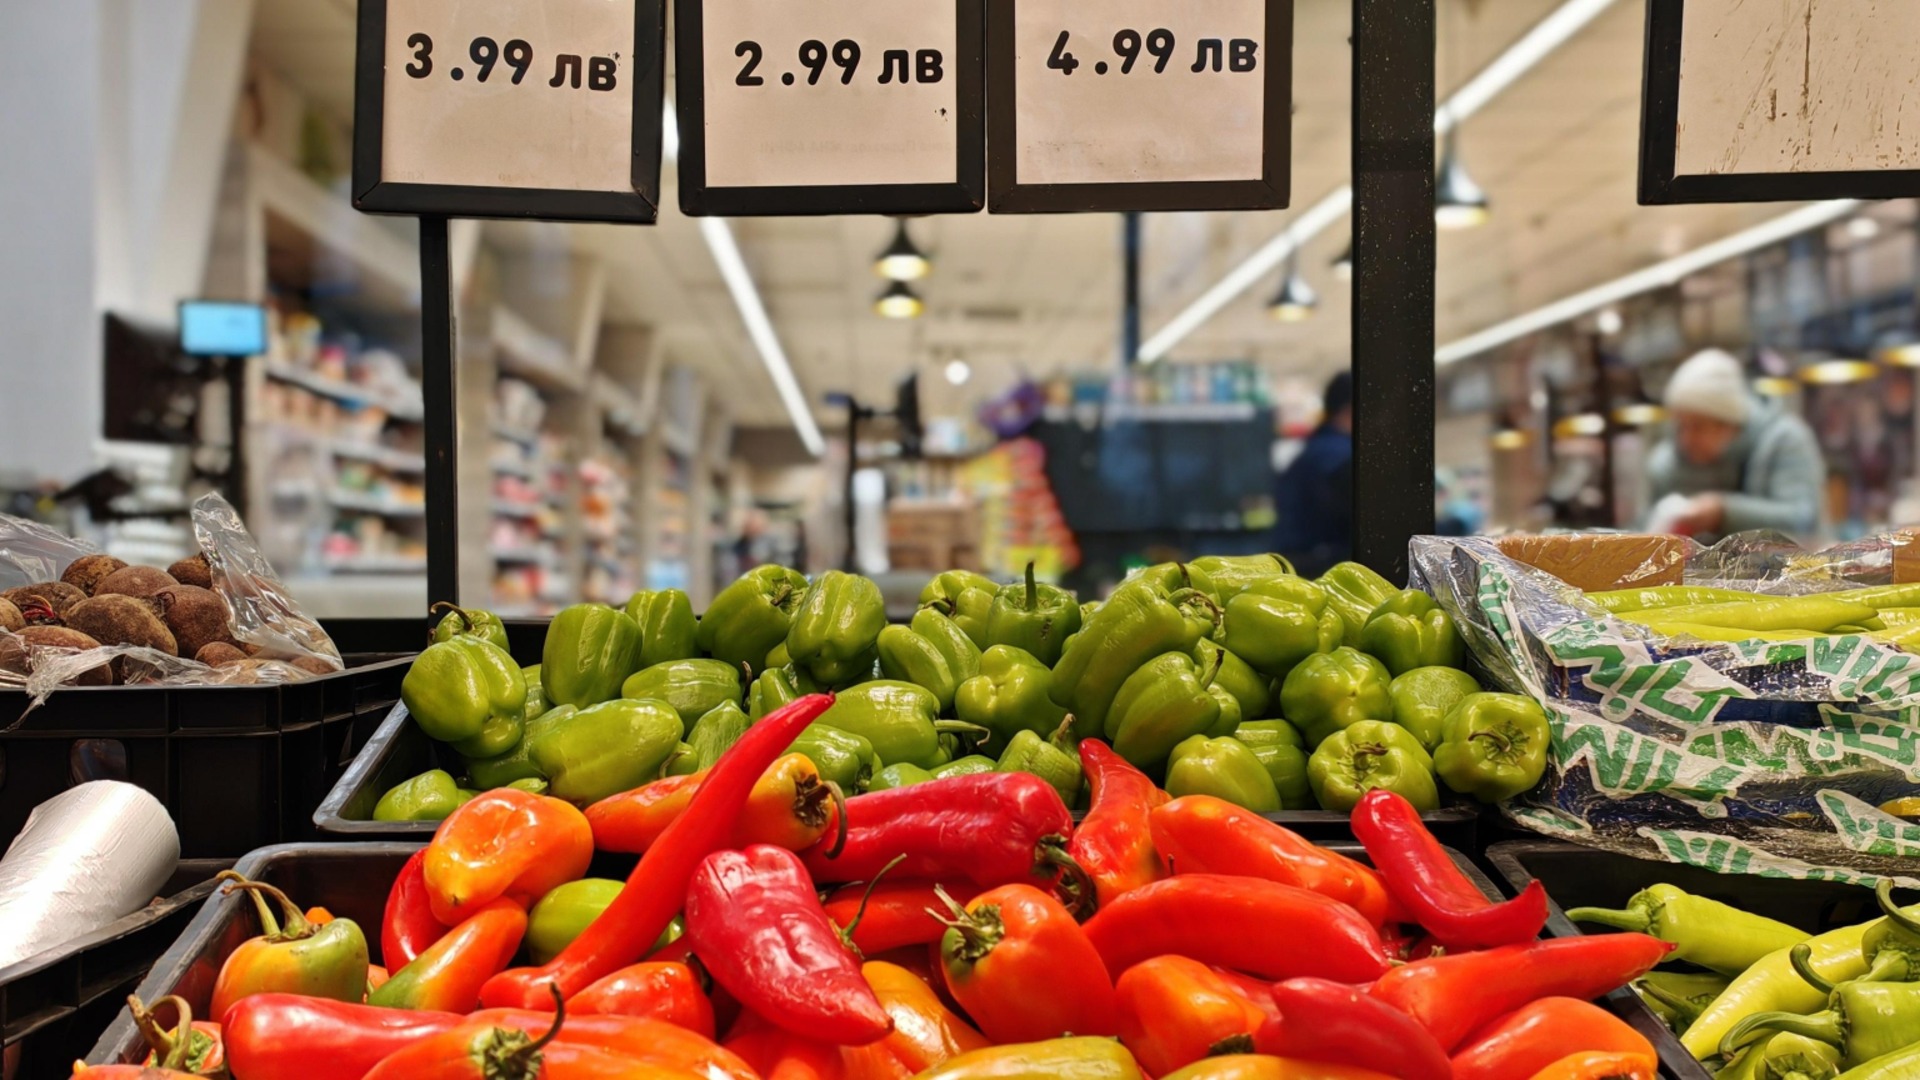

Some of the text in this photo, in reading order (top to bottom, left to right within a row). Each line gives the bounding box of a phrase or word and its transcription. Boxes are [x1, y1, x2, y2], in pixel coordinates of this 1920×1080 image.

[548, 54, 617, 92] лв
[877, 49, 944, 84] лв
[1190, 38, 1258, 73] лв
